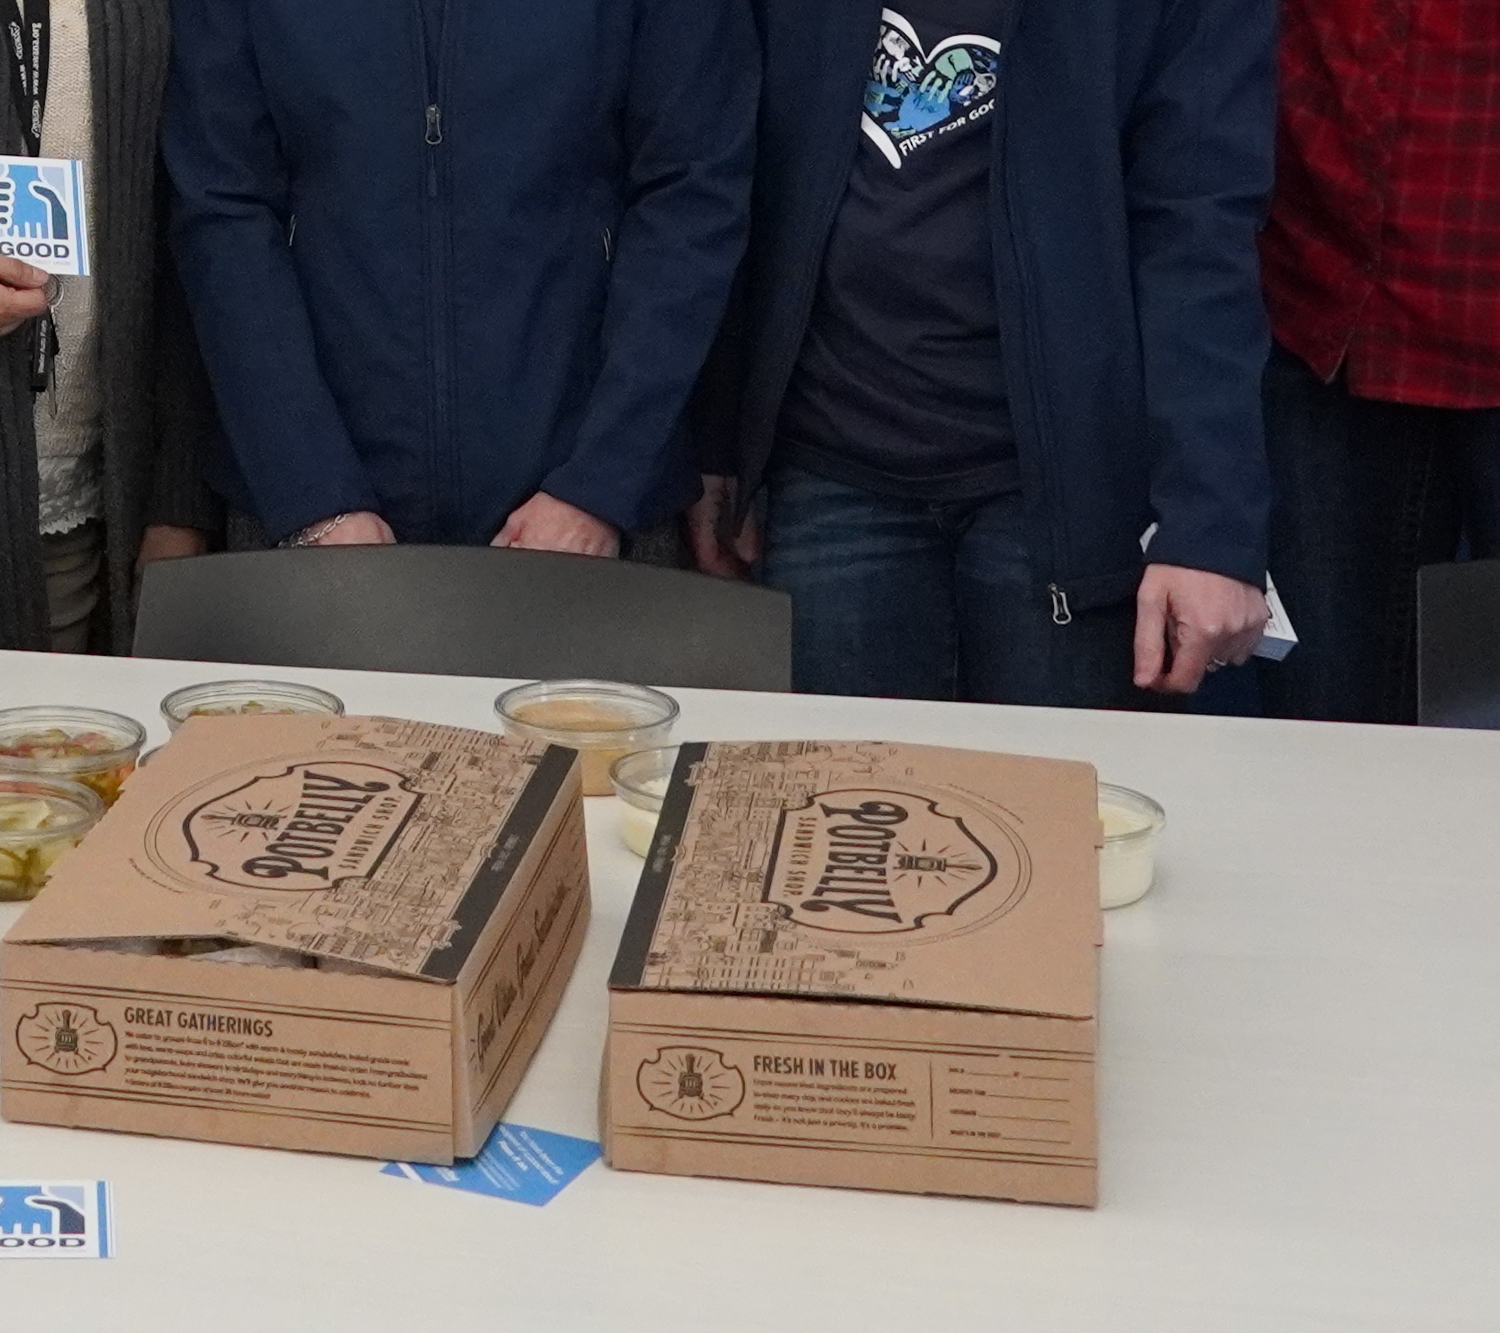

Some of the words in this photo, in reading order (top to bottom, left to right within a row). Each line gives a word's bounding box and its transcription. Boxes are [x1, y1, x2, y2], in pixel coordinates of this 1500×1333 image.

[899, 131, 934, 157] FIRST
[938, 117, 966, 135] FOR
[242, 769, 390, 881] POTBELLY
[339, 823, 384, 870] SANDWICH
[790, 817, 817, 865] SANDWICH
[800, 801, 908, 923] POTBELLY
[124, 1007, 173, 1027] GREAT
[177, 1012, 273, 1037] GATHERINGS
[754, 1055, 804, 1075] FRESH
[809, 1058, 824, 1077] IN
[829, 1059, 859, 1079] THE
[864, 1062, 897, 1081] BOX
